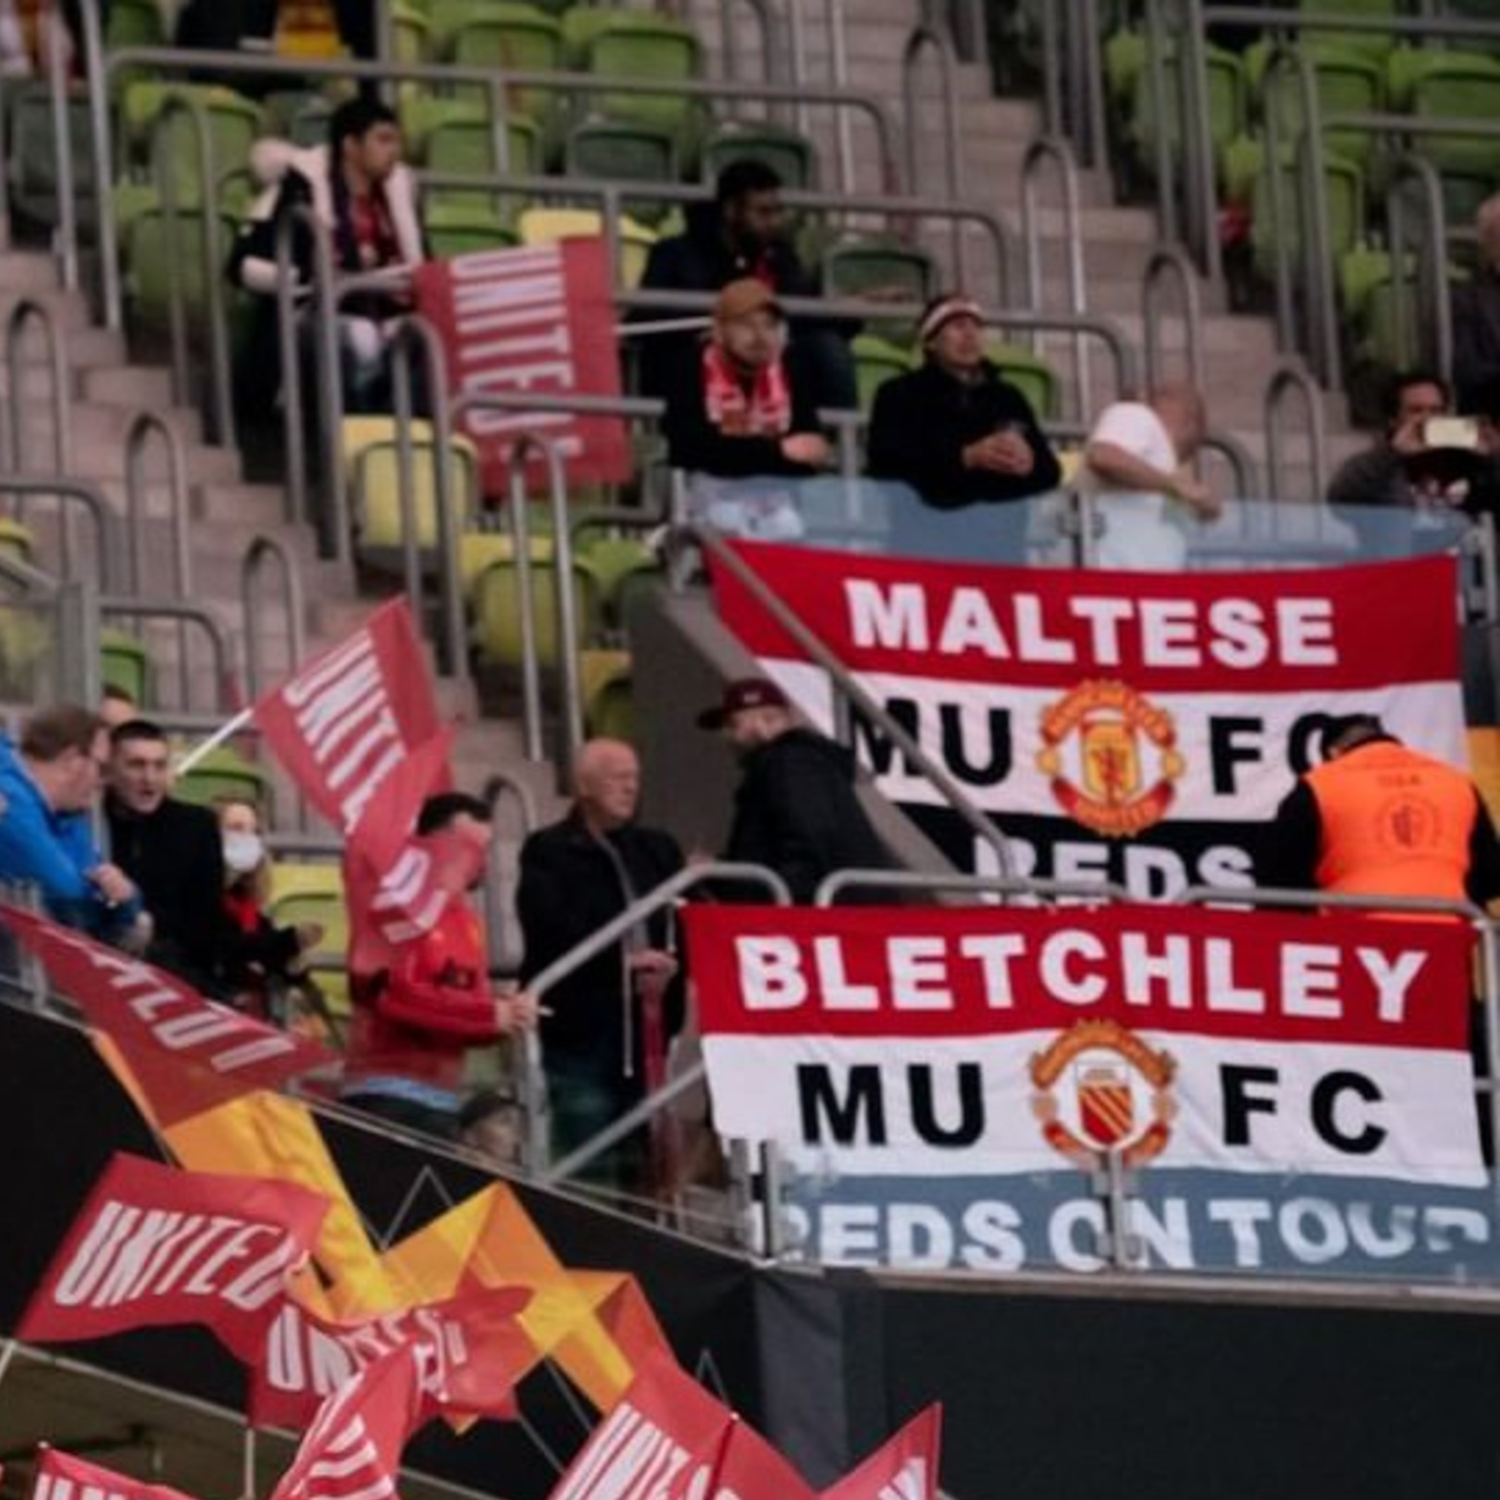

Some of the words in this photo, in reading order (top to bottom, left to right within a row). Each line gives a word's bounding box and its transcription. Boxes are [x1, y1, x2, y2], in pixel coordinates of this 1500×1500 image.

[844, 579, 1338, 667] MALTESE
[735, 930, 1428, 1022] BLETCHLEY
[797, 1064, 984, 1148] MU
[1220, 1065, 1389, 1155] FC
